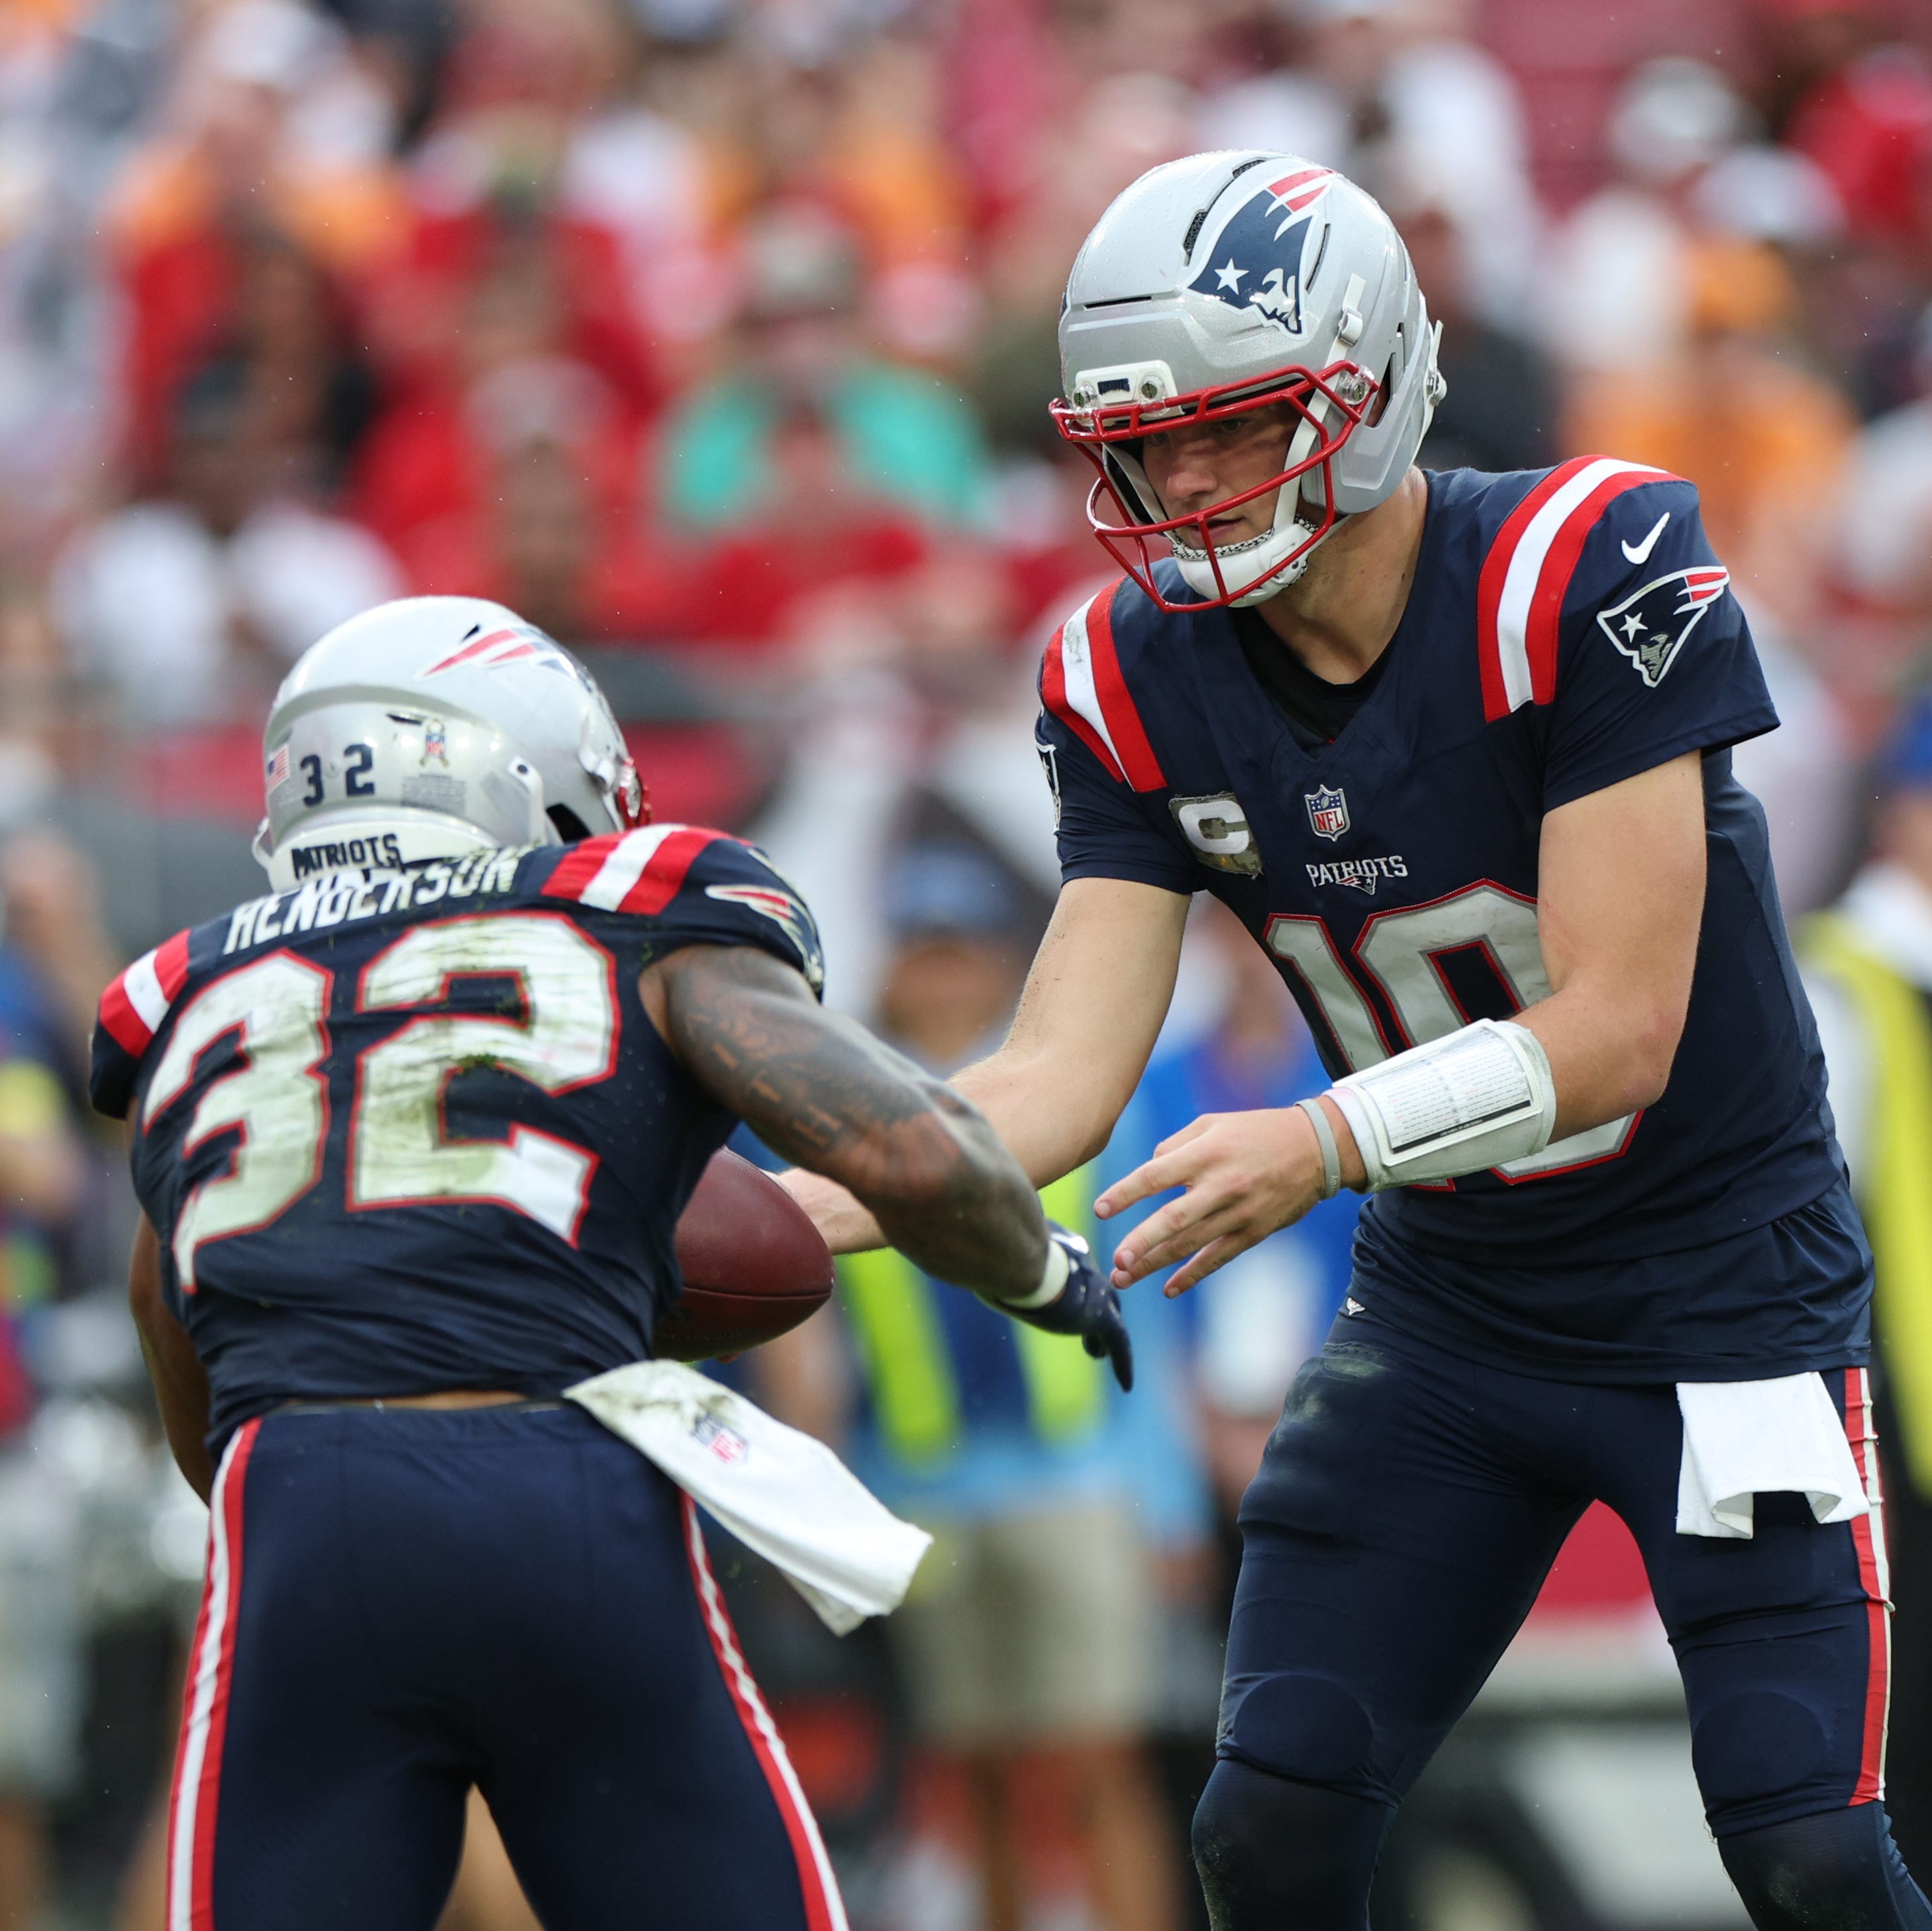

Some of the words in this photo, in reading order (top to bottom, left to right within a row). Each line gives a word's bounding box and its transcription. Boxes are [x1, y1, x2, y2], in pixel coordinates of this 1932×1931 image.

[300, 744, 375, 807] 32
[1178, 800, 1250, 854] C
[1315, 810, 1344, 832] NFL
[291, 833, 404, 881] PATRIOTS
[1305, 855, 1409, 888] PATRIOTS
[143, 910, 621, 1295] 32
